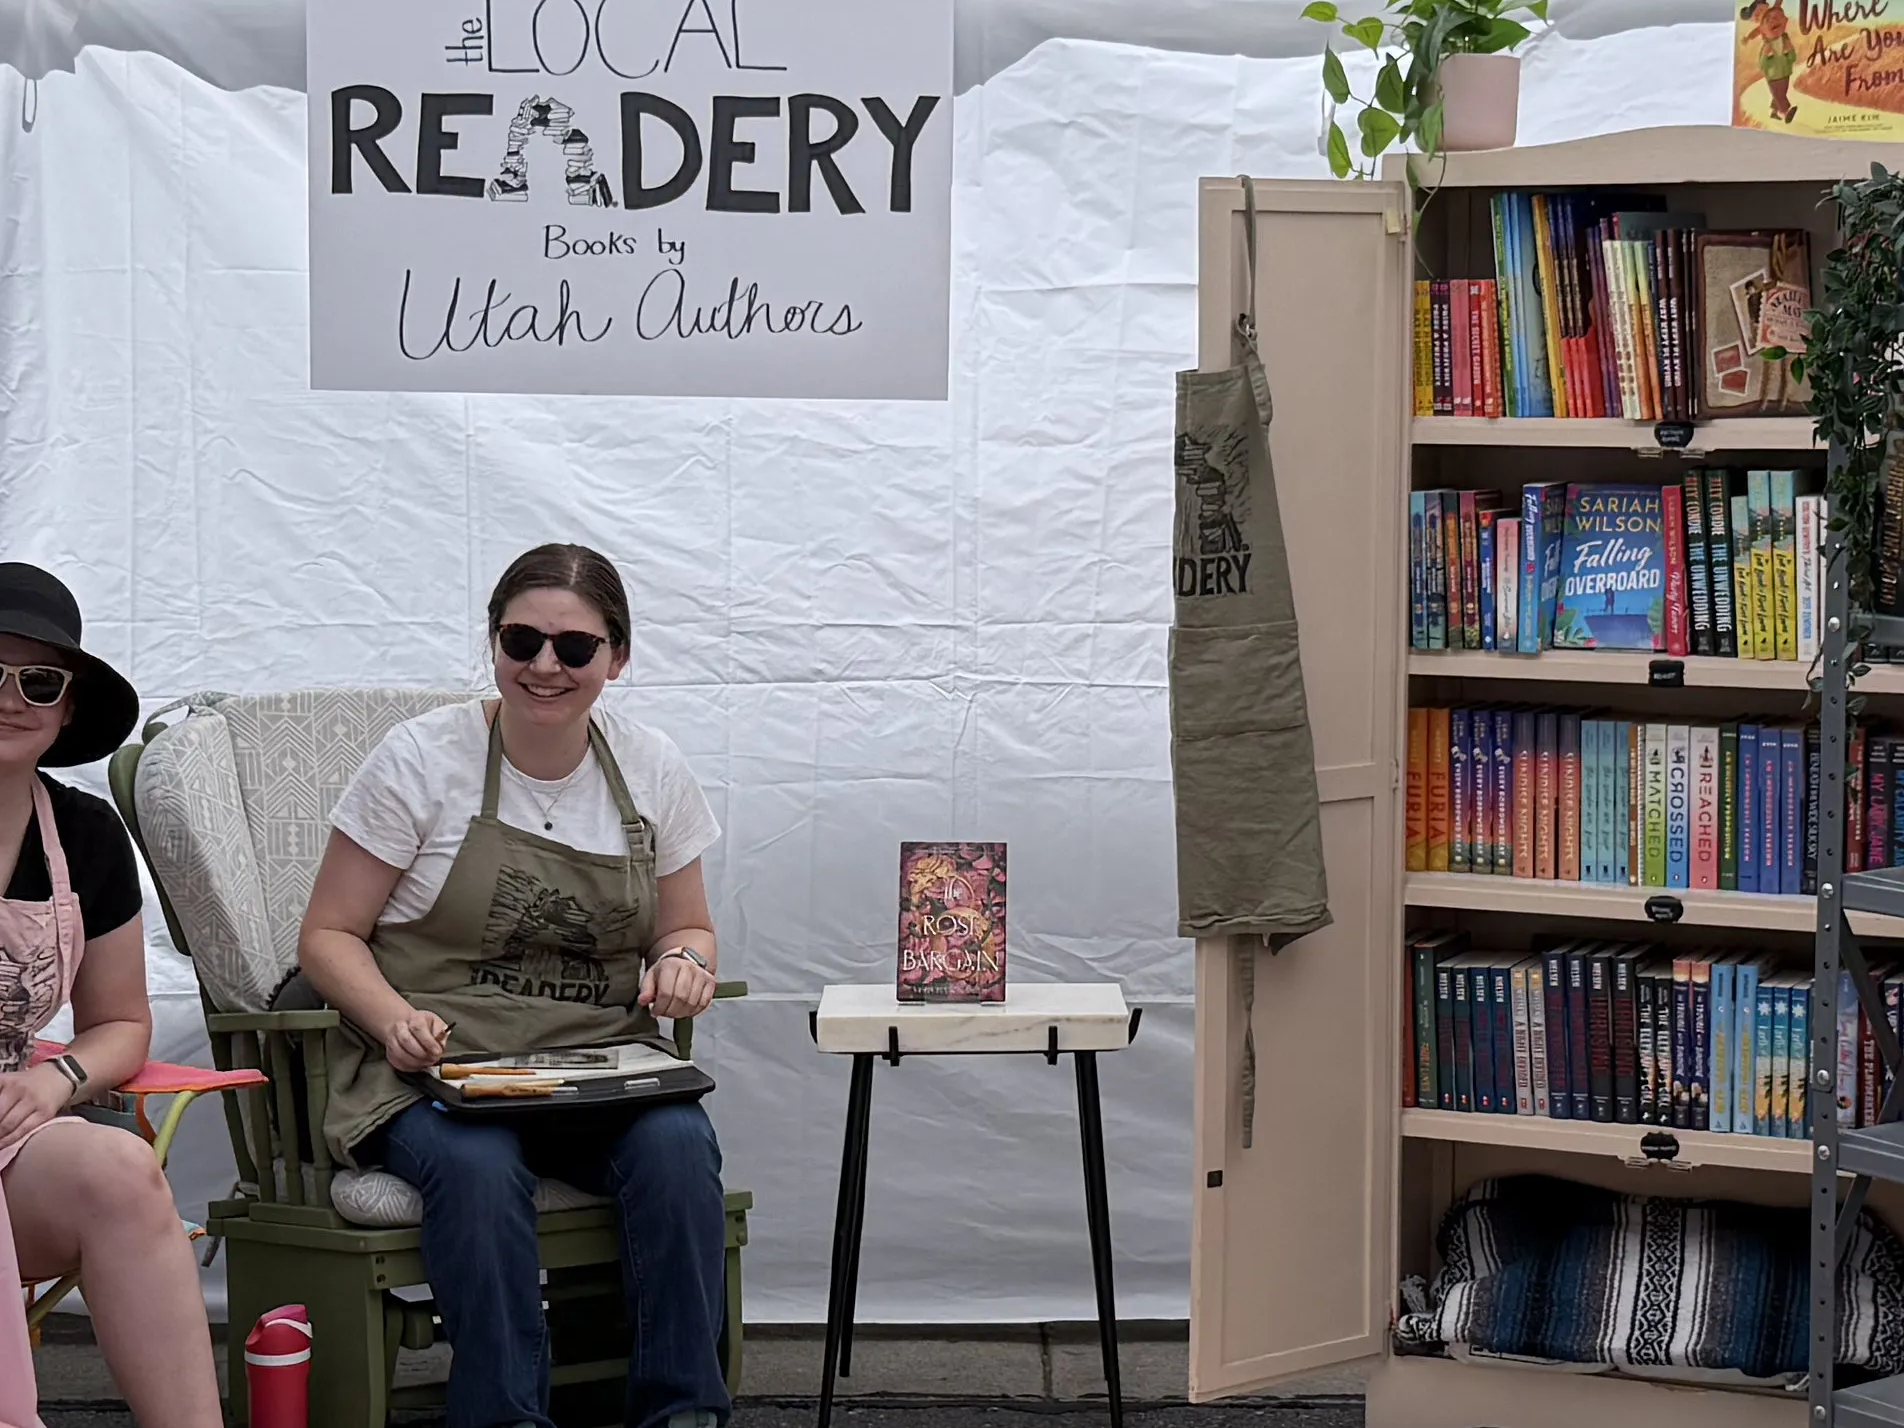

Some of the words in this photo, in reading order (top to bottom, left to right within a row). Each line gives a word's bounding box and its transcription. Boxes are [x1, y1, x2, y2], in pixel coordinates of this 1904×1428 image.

[445, 18, 484, 67] the
[1807, 36, 1855, 68] Are
[329, 84, 941, 215] READERY
[543, 225, 637, 260] Books
[657, 224, 687, 265] by
[398, 269, 612, 361] Utah
[636, 269, 862, 341] Authors
[1576, 516, 1662, 532] WILSON
[1579, 497, 1660, 513] SARIAH
[1573, 539, 1652, 572] Falling
[1690, 542, 1704, 560] THE
[1712, 544, 1727, 561] THE
[1173, 553, 1251, 599] DERY
[1565, 569, 1660, 596] OVERBOARD
[1692, 565, 1710, 630] UNWEDDING
[1714, 567, 1732, 632] UNWEDDING
[1871, 773, 1883, 791] MY
[1407, 772, 1422, 839] FURIA
[1430, 772, 1447, 839] FURIA
[1648, 771, 1661, 858] MATCHED
[1698, 773, 1712, 861] REACHED
